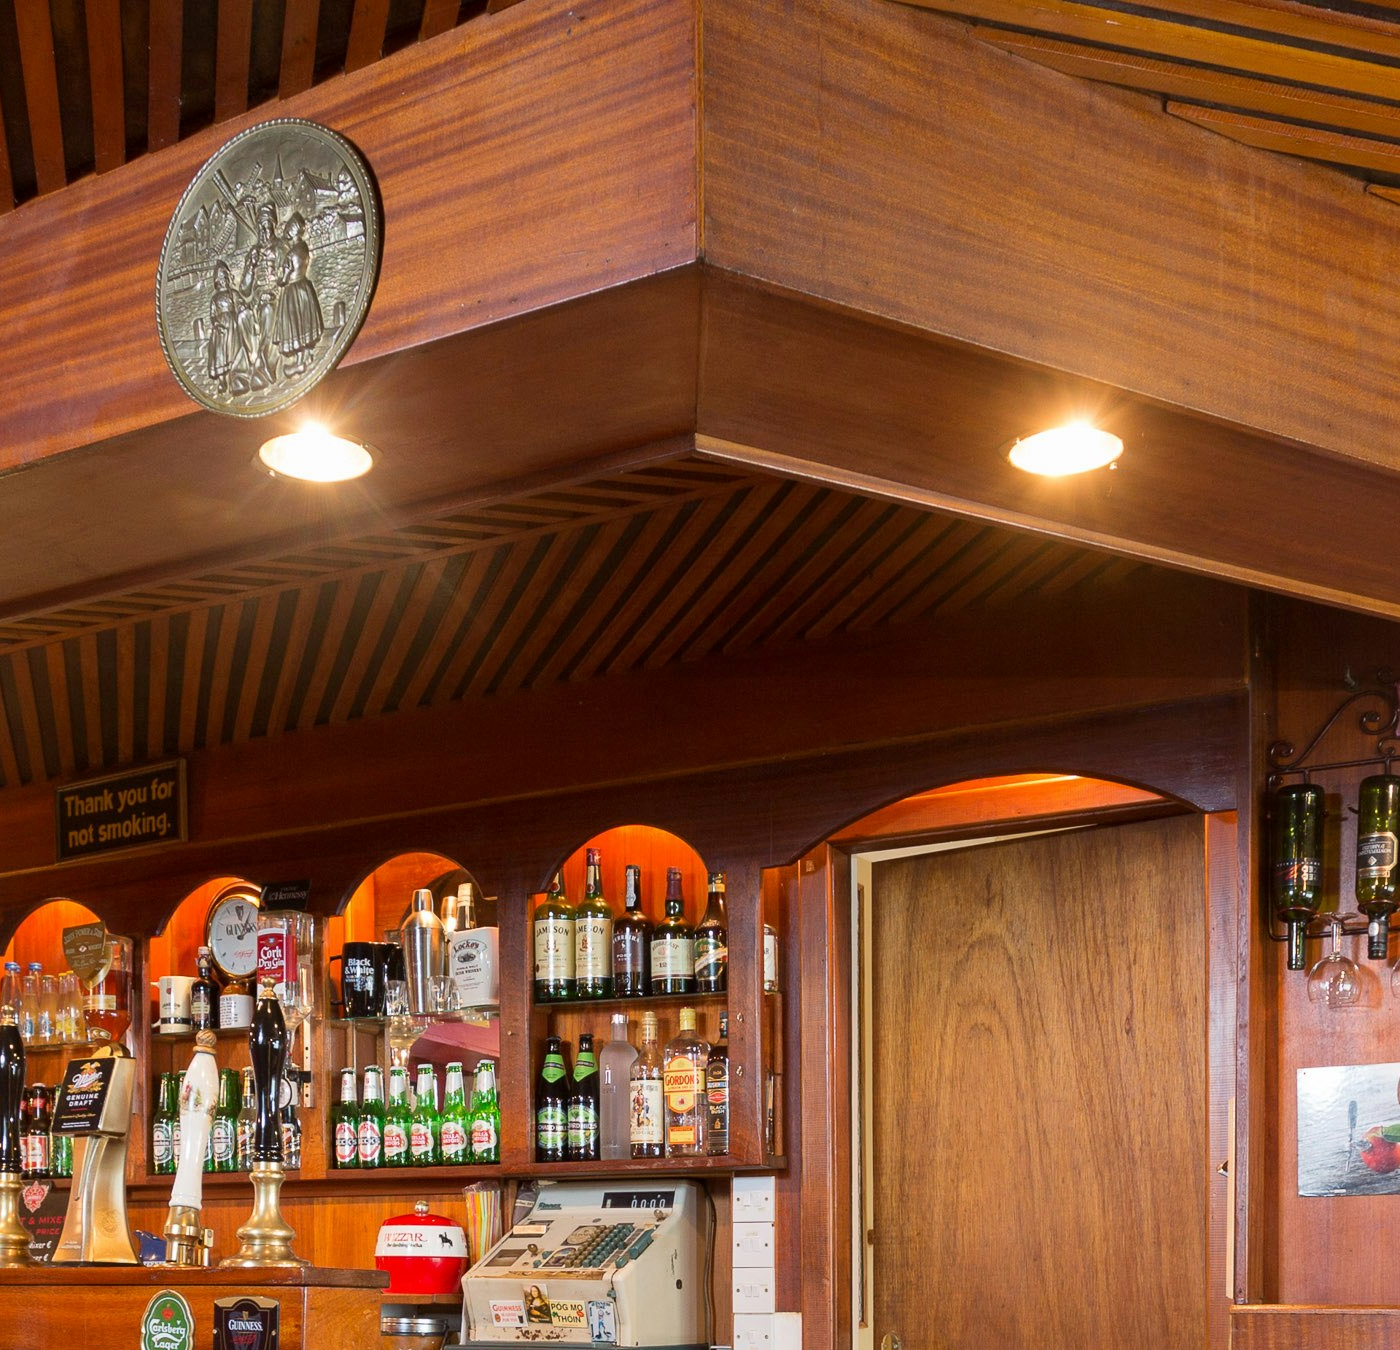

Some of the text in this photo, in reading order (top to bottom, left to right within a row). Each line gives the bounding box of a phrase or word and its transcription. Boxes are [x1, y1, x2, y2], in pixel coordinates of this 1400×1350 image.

[64, 778, 175, 817] Thank you for
[68, 812, 171, 848] not smoking.
[258, 958, 285, 970] Dry Gin
[347, 958, 371, 967] Black
[66, 1093, 99, 1101] GENUINE
[36, 1228, 60, 1236] PRICE
[149, 1318, 186, 1338] Carlsberg
[228, 1320, 263, 1331] GUINNESS
